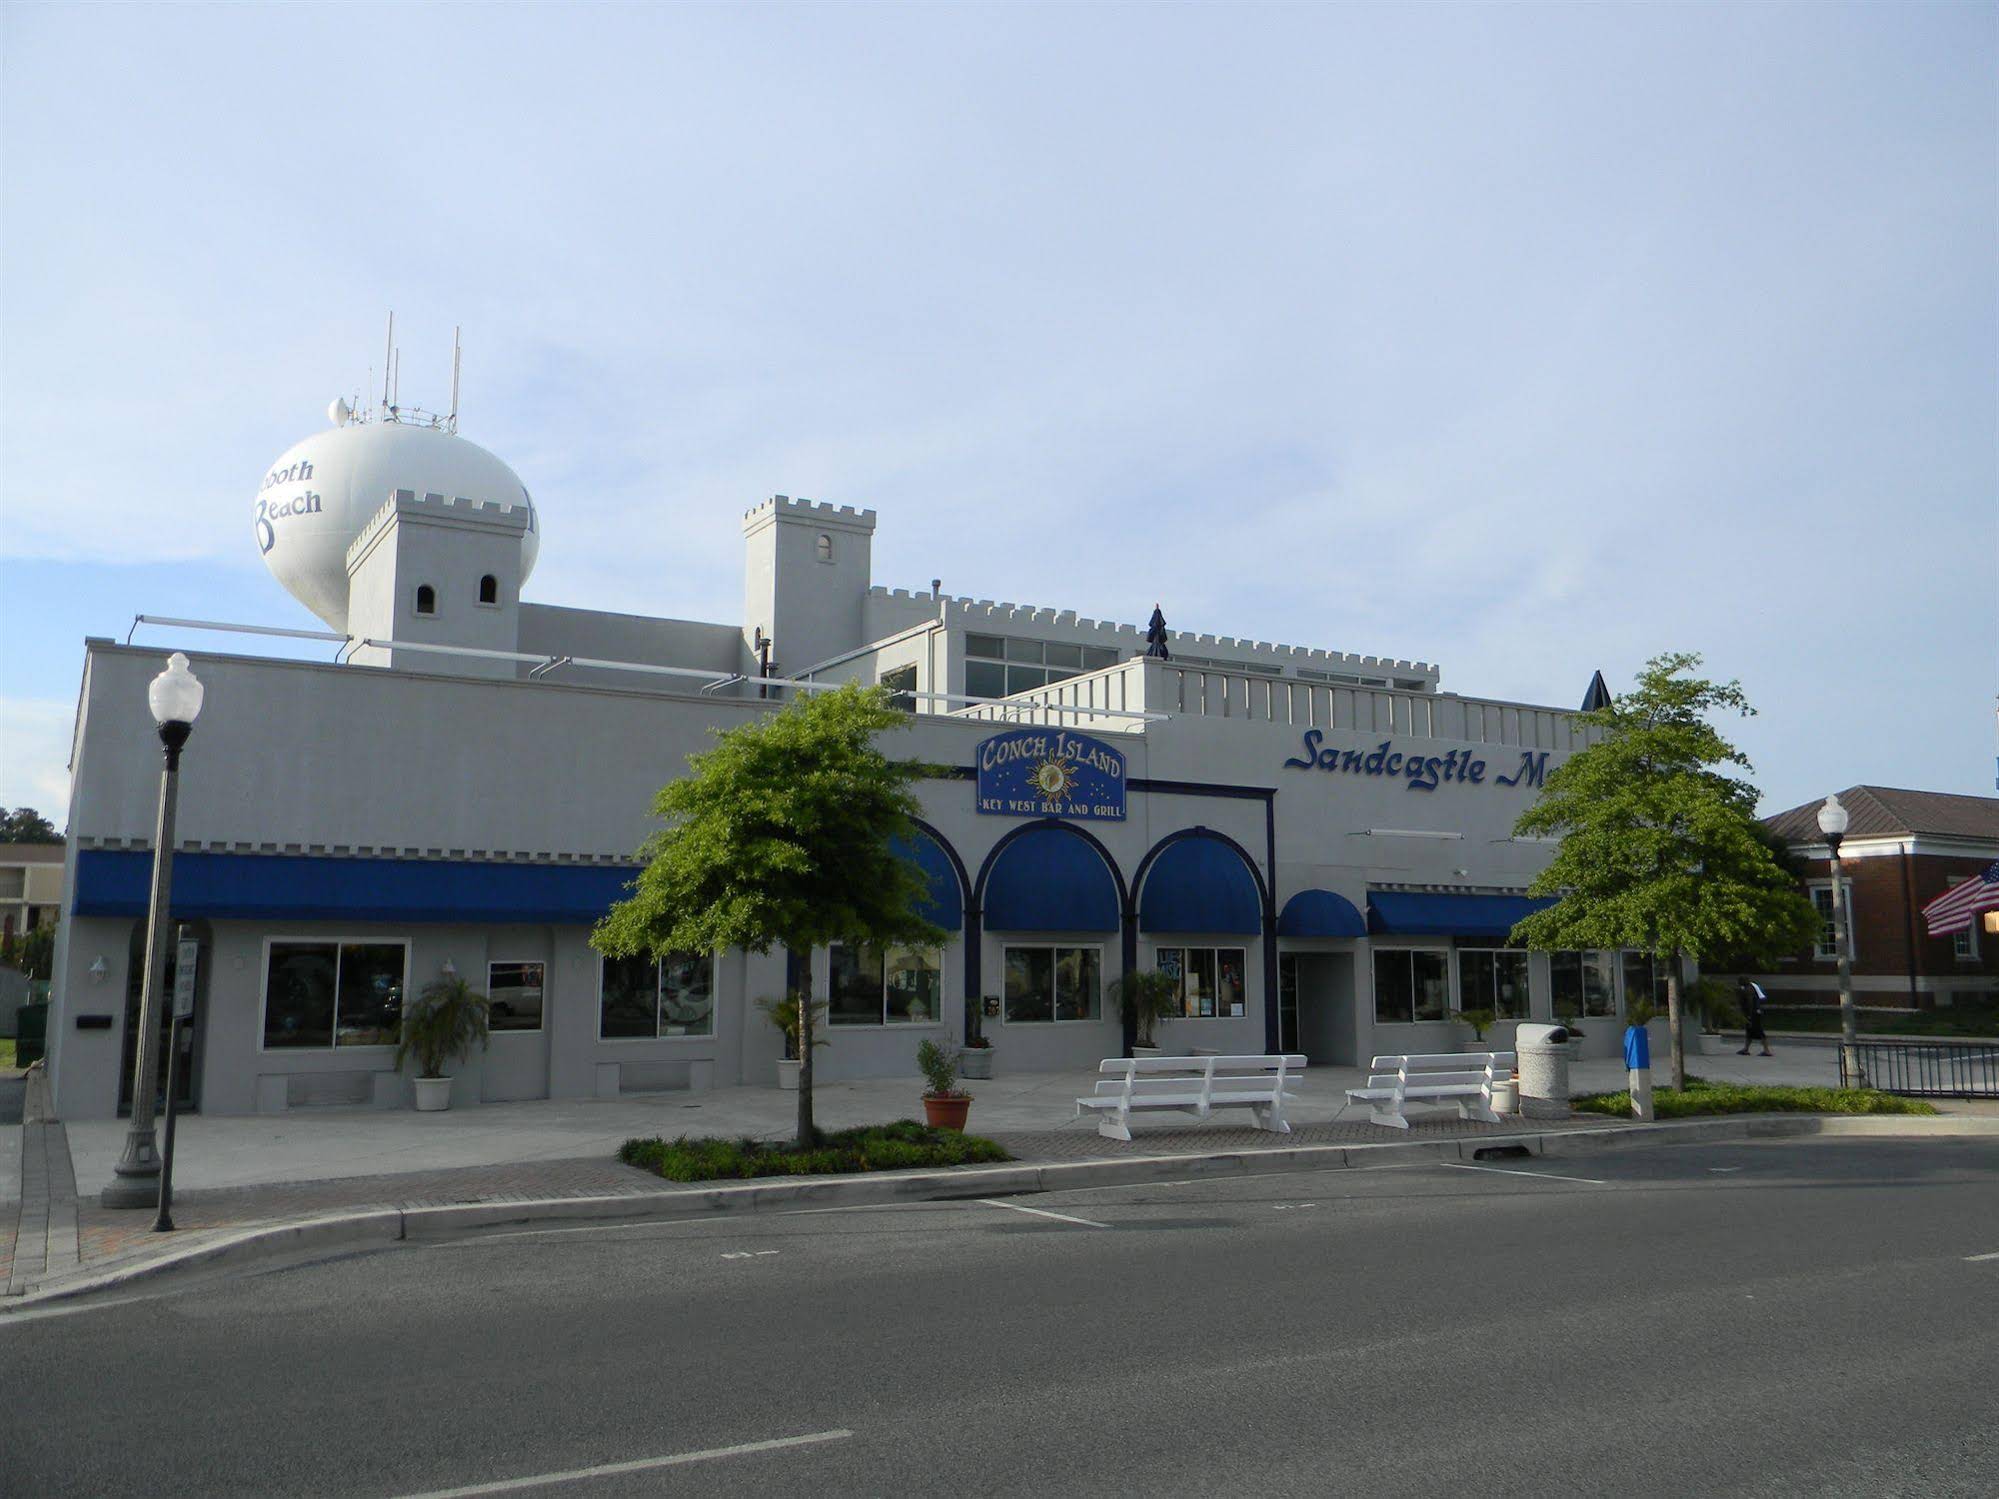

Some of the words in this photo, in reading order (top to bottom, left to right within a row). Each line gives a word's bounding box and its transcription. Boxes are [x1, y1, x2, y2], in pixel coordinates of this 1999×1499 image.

[254, 490, 323, 556] Beach
[982, 736, 1047, 772] CONCH
[1056, 731, 1121, 779] ISLAND
[1283, 729, 1486, 792] Sandcastle
[1495, 751, 1561, 789] M
[982, 798, 1003, 810] KEY
[1009, 799, 1037, 812] WEST
[1041, 802, 1062, 814] BAR
[1068, 803, 1088, 815] AND
[1094, 805, 1121, 817] GRILL
